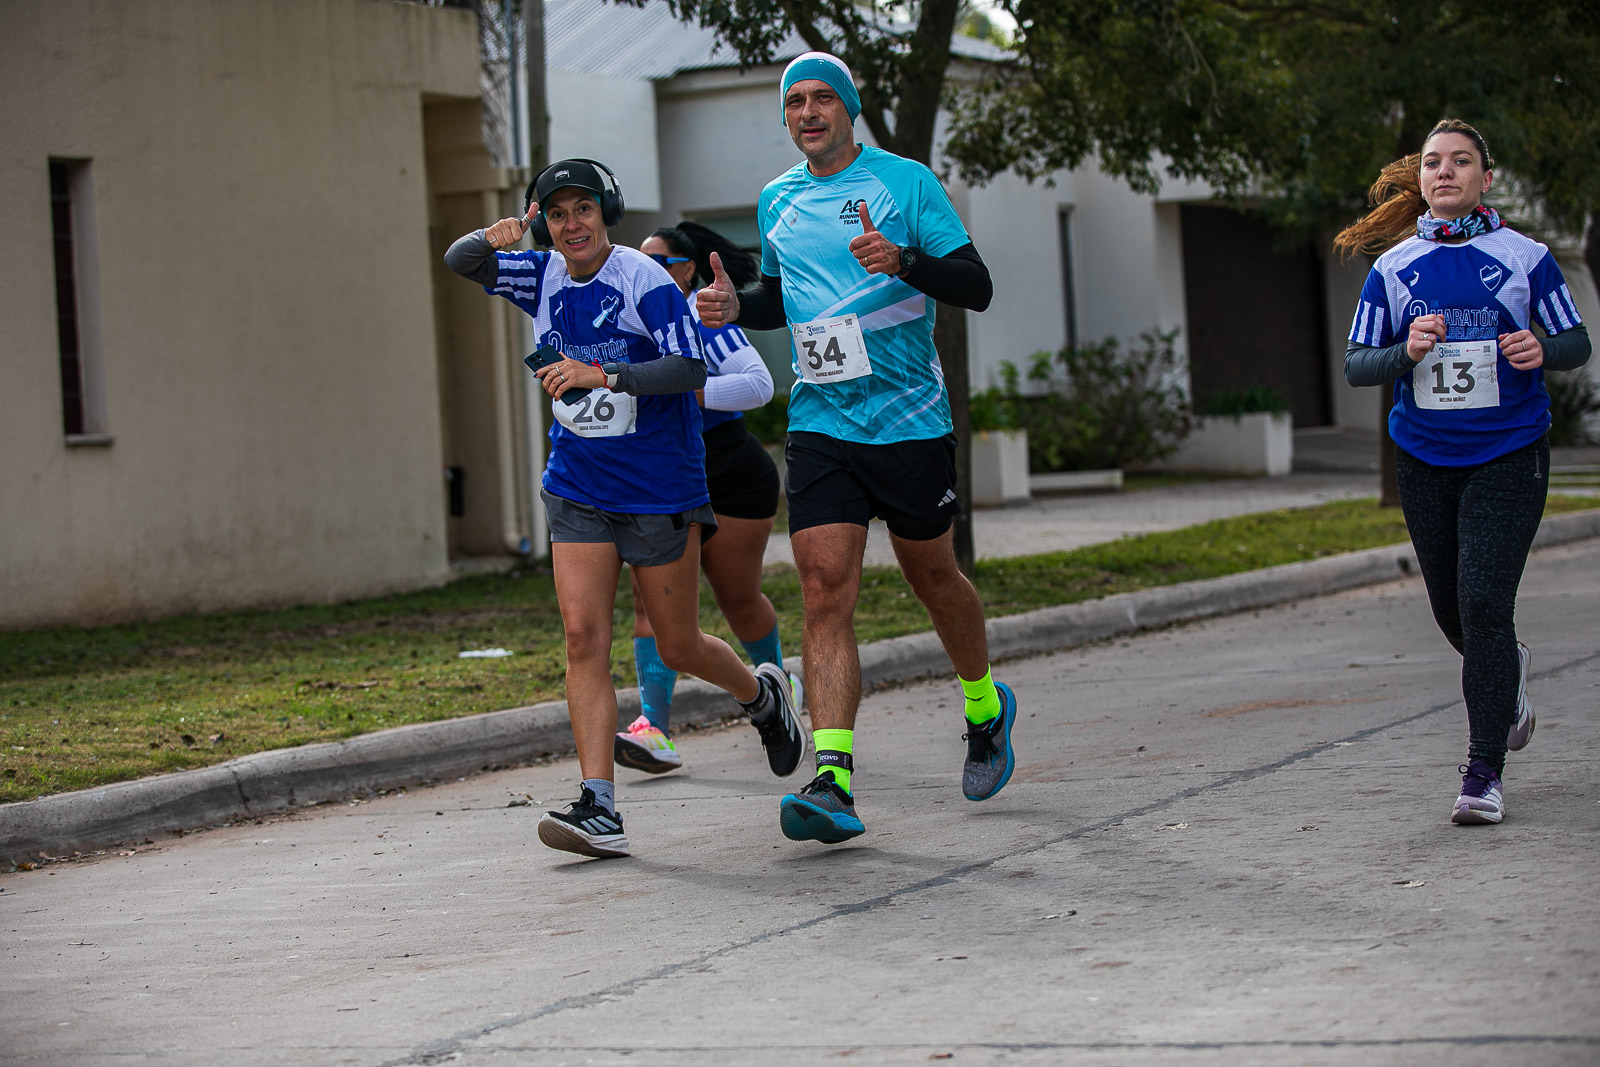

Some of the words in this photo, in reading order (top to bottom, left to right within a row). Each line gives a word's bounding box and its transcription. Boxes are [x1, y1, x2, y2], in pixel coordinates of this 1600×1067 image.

[801, 336, 847, 370] 34
[1431, 361, 1476, 394] 13
[572, 393, 616, 424] 26
